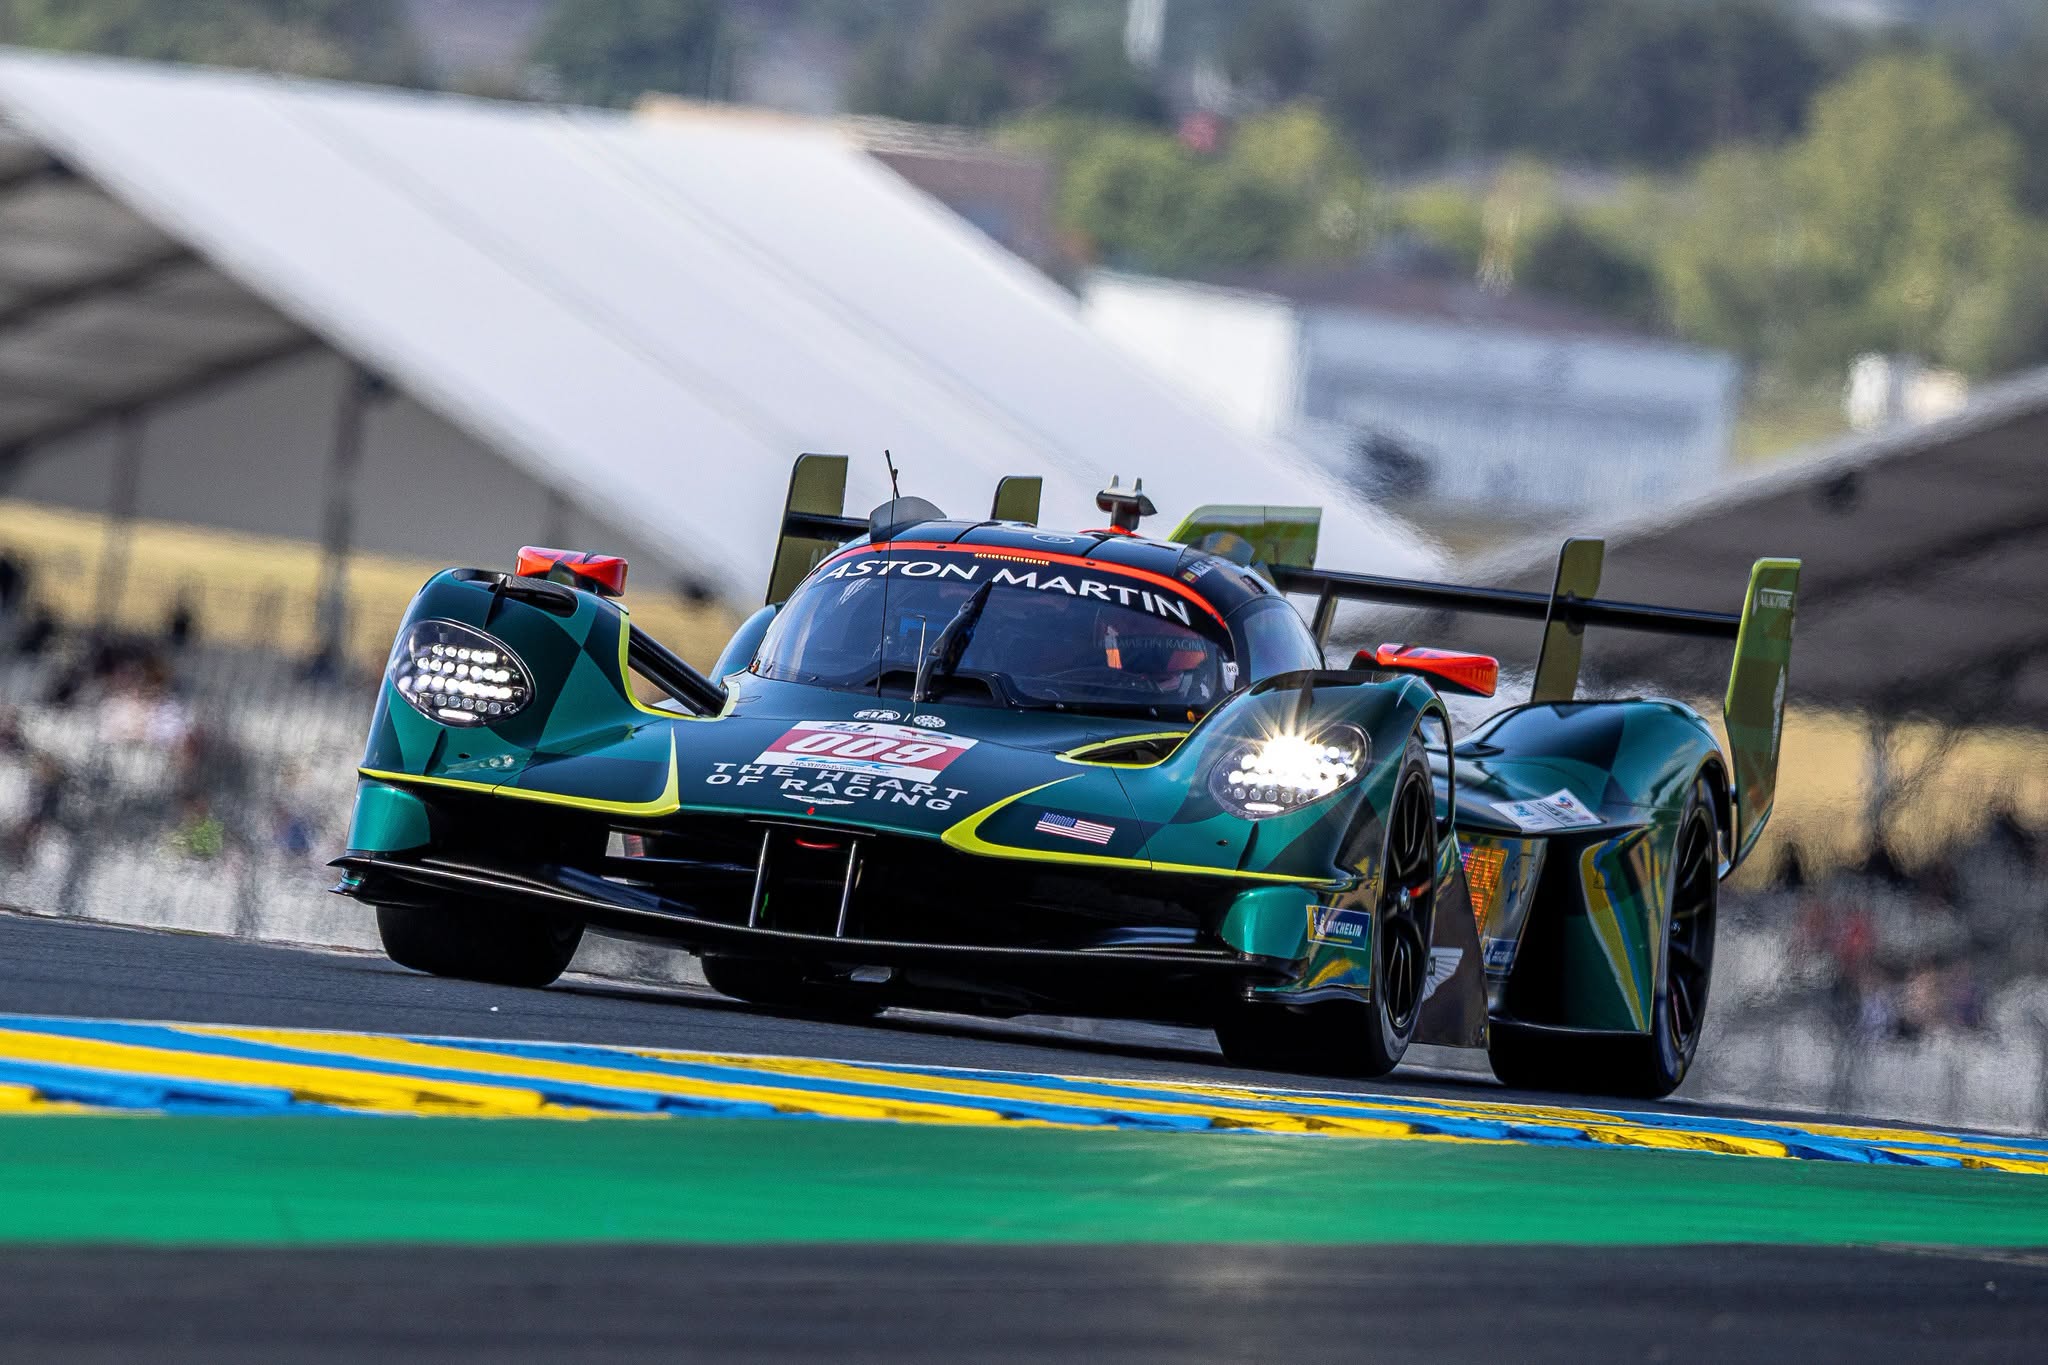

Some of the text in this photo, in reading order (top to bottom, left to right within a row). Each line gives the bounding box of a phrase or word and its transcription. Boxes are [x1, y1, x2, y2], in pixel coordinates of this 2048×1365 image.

[817, 560, 980, 584] ASTON
[992, 568, 1192, 626] MARTIN
[857, 710, 895, 721] FIA
[785, 732, 948, 764] 009
[706, 774, 952, 811] OF RACING
[713, 762, 800, 777] THE
[815, 770, 969, 800] HEART
[1326, 920, 1363, 937] MICHELIN
